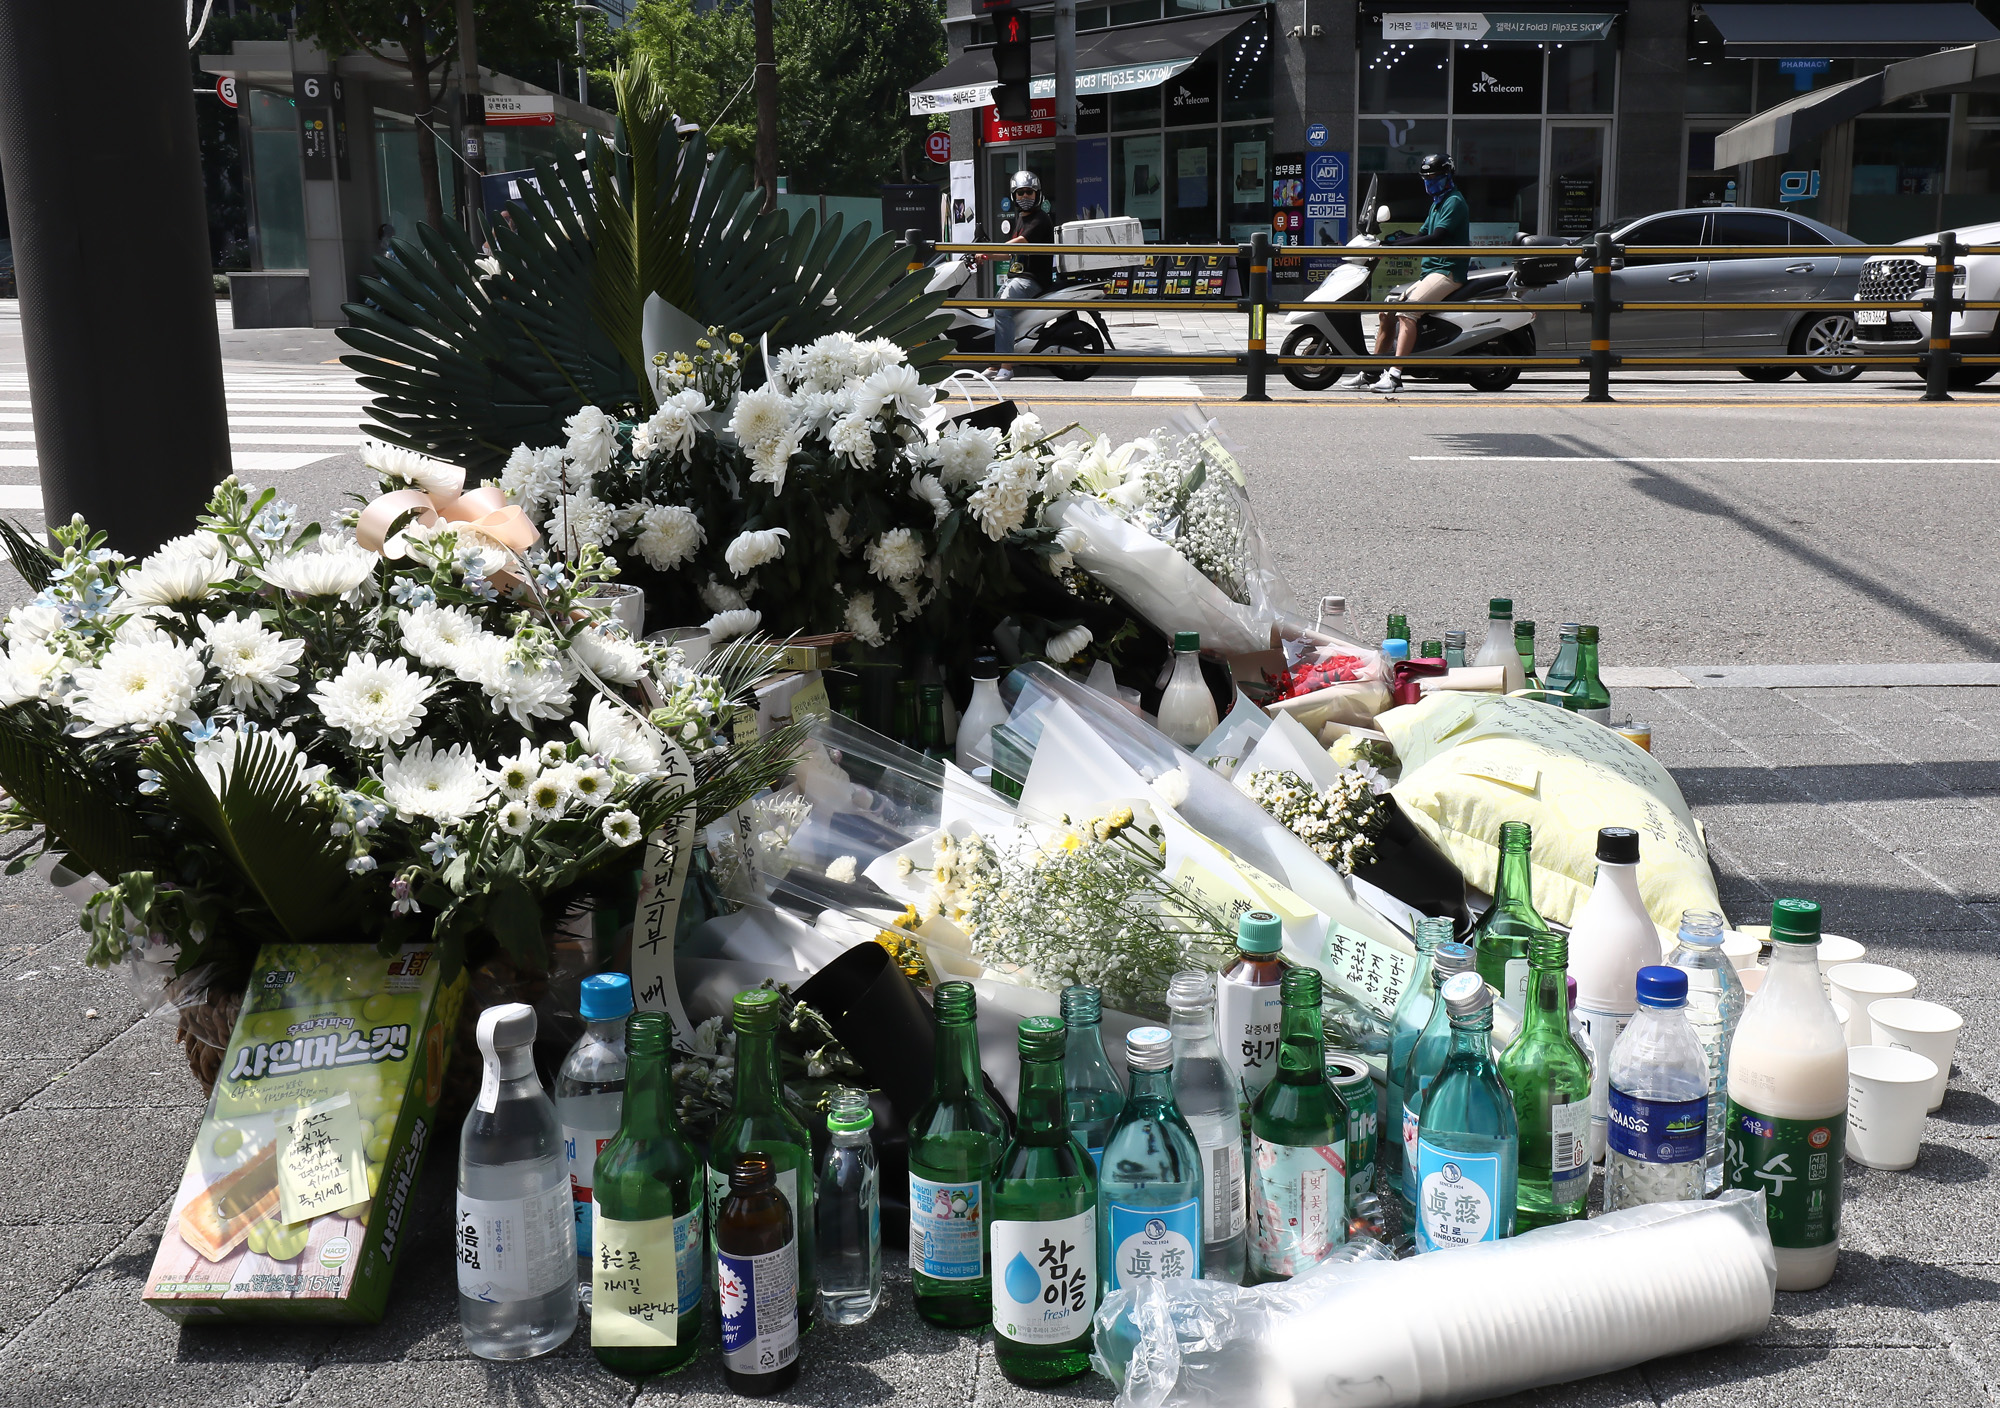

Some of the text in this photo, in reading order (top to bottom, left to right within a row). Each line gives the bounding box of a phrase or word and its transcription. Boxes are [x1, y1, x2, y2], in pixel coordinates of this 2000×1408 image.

[1389, 21, 1412, 31] 가격은
[1430, 21, 1453, 31] 혜택은
[1455, 21, 1478, 31] 펼치고
[1496, 22, 1518, 32] 갤럭시
[1519, 23, 1525, 31] Z
[1526, 23, 1548, 31] Fold3
[304, 78, 320, 98] 6
[334, 81, 341, 99] 6
[1472, 82, 1524, 93] SK telecom
[912, 94, 936, 109] 가격은
[1173, 96, 1210, 106] SK telecom
[1079, 107, 1101, 116] telecom
[997, 123, 1043, 138] 공식 인증 대리점
[1309, 131, 1325, 140] ADT
[1275, 164, 1302, 176] 업무용폰
[1317, 166, 1338, 178] ADT
[1309, 193, 1345, 202] ADT캡스
[1309, 205, 1345, 216] 도어가드
[1274, 256, 1301, 267] EVENT!
[287, 1017, 355, 1036] 후렌치파이
[1244, 1023, 1271, 1036] 갈증에
[229, 1025, 409, 1081] 샤인머스캣
[1744, 1118, 1764, 1137] 서울
[1627, 1148, 1648, 1159] 500 mL
[1439, 1180, 1453, 1189] SINCE
[1433, 1230, 1469, 1245] JINRO SOJU
[324, 1247, 347, 1255] HACCP
[601, 1243, 641, 1271] 좋은 곳
[1038, 1238, 1075, 1280] 참
[308, 1275, 345, 1292] 15개입
[603, 1277, 643, 1295] 가시길
[1043, 1267, 1087, 1312] 이슬
[628, 1303, 679, 1322] 바랍니다
[1043, 1307, 1070, 1322] fresh
[724, 1321, 742, 1332] Your
